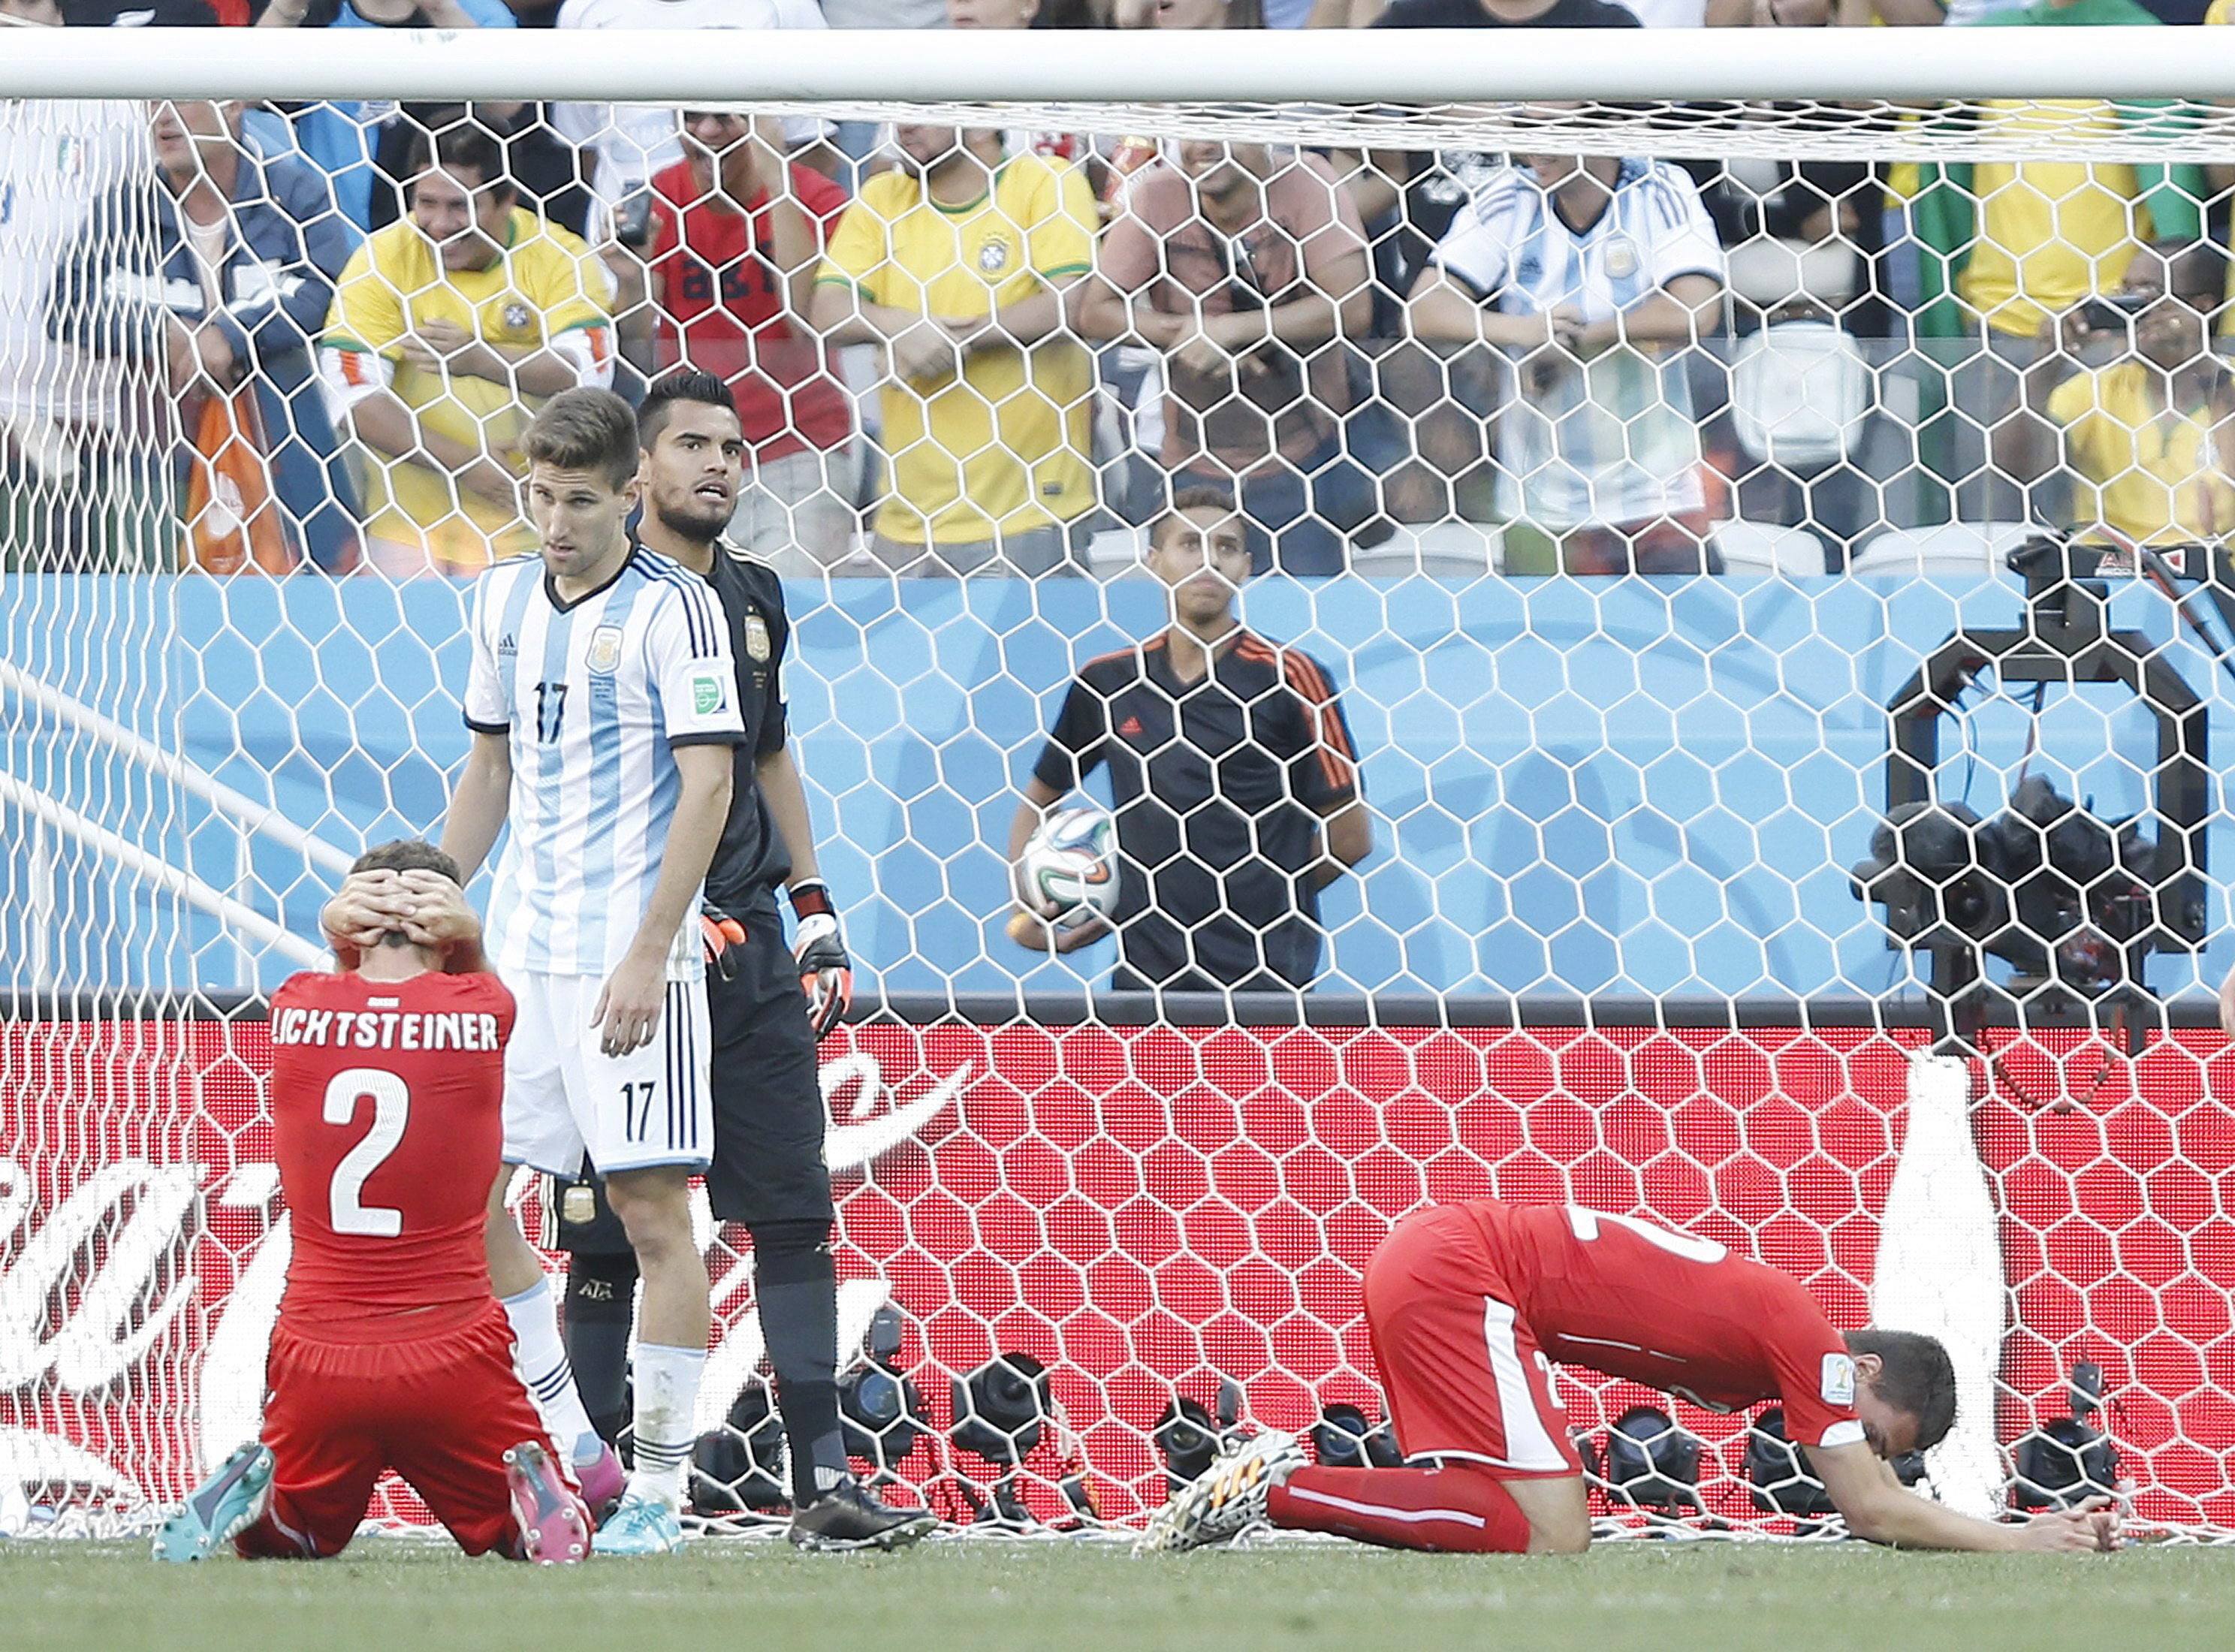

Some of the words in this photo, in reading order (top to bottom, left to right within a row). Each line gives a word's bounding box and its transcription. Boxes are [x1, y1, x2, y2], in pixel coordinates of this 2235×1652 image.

[533, 681, 569, 744] 17
[619, 1081, 657, 1143] 17
[323, 1067, 410, 1238] 2
